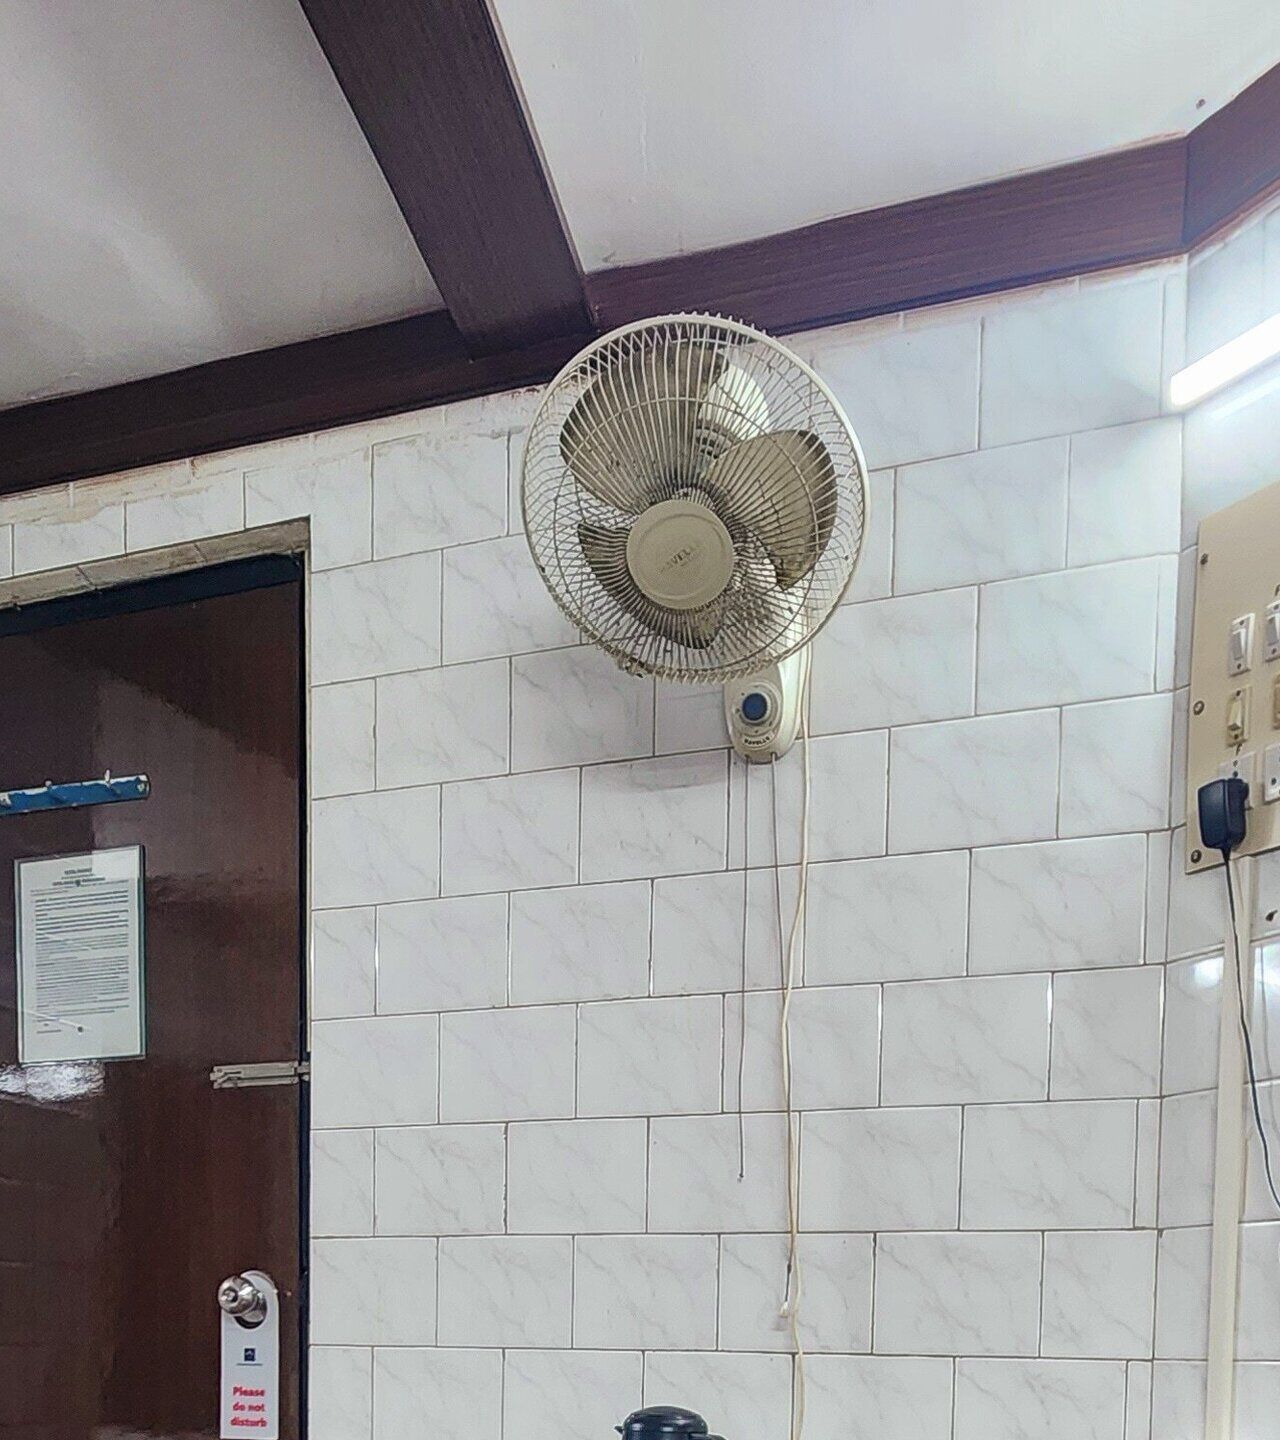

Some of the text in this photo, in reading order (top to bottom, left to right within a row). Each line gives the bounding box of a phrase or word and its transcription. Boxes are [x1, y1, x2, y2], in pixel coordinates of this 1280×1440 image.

[232, 1386, 265, 1397] Please
[232, 1401, 265, 1412] do not
[230, 1416, 268, 1428] disturb
